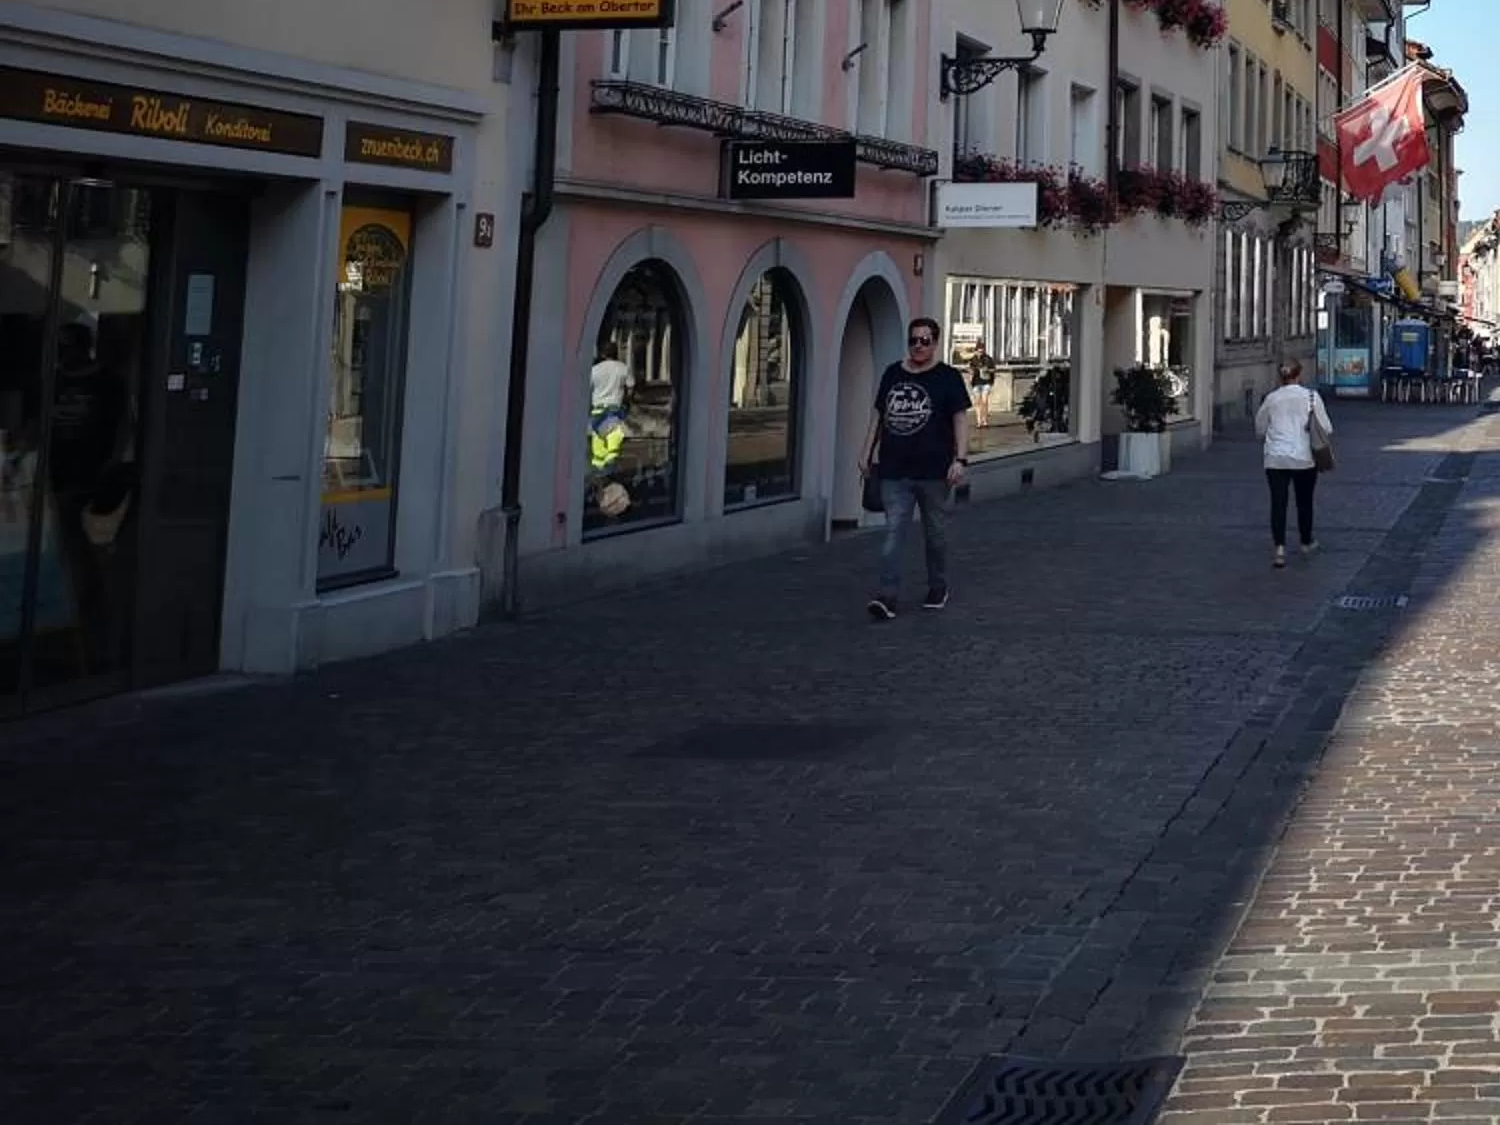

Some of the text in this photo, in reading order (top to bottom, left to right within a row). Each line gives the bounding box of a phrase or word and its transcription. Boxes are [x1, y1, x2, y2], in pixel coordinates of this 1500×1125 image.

[514, 0, 655, 15] Ihr Beck am Obertor
[43, 88, 273, 143] Bäckerei Riboli Konditorei
[739, 149, 788, 164] Licht-
[737, 170, 833, 187] Kompetenz
